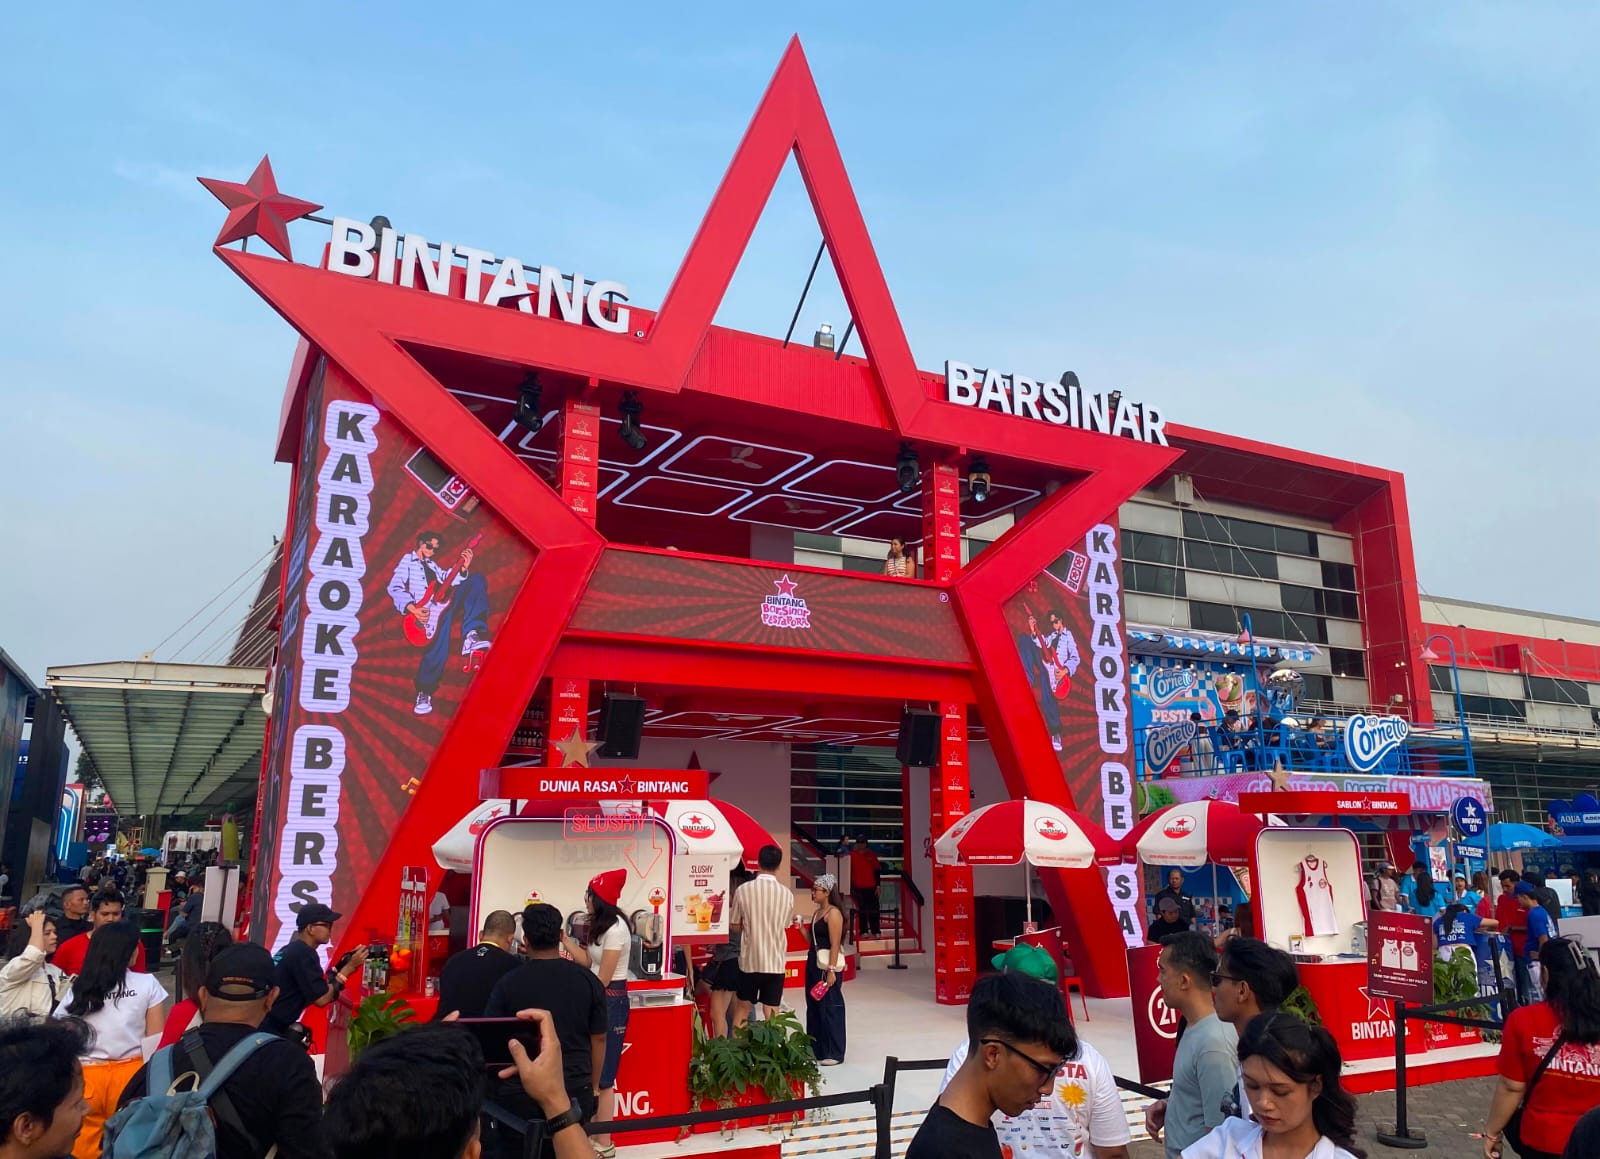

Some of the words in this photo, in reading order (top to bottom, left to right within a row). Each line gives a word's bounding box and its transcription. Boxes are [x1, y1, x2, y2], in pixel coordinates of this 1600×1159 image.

[328, 216, 630, 333] BINTANG
[945, 360, 1169, 446] BARSINAR
[312, 411, 367, 700] KARAOKE
[766, 596, 804, 608] BINTANG
[1092, 531, 1121, 745] KARAOKE
[1150, 668, 1194, 703] Cornetto
[1146, 722, 1197, 772] Cornetto
[1350, 715, 1408, 769] Cornetto
[539, 780, 581, 793] DUNIA
[583, 780, 618, 793] RASA
[637, 781, 689, 793] BINTANG
[1336, 800, 1362, 809] SABLON
[1371, 801, 1398, 810] BINTANG
[571, 812, 647, 833] SLUSHY
[1560, 815, 1581, 824] AQUA
[288, 737, 334, 943] BERS
[691, 864, 714, 874] SLUSHY
[104, 989, 136, 1001] NTANG
[1351, 1019, 1409, 1040] BINTAN
[1547, 1056, 1600, 1077] INTAN
